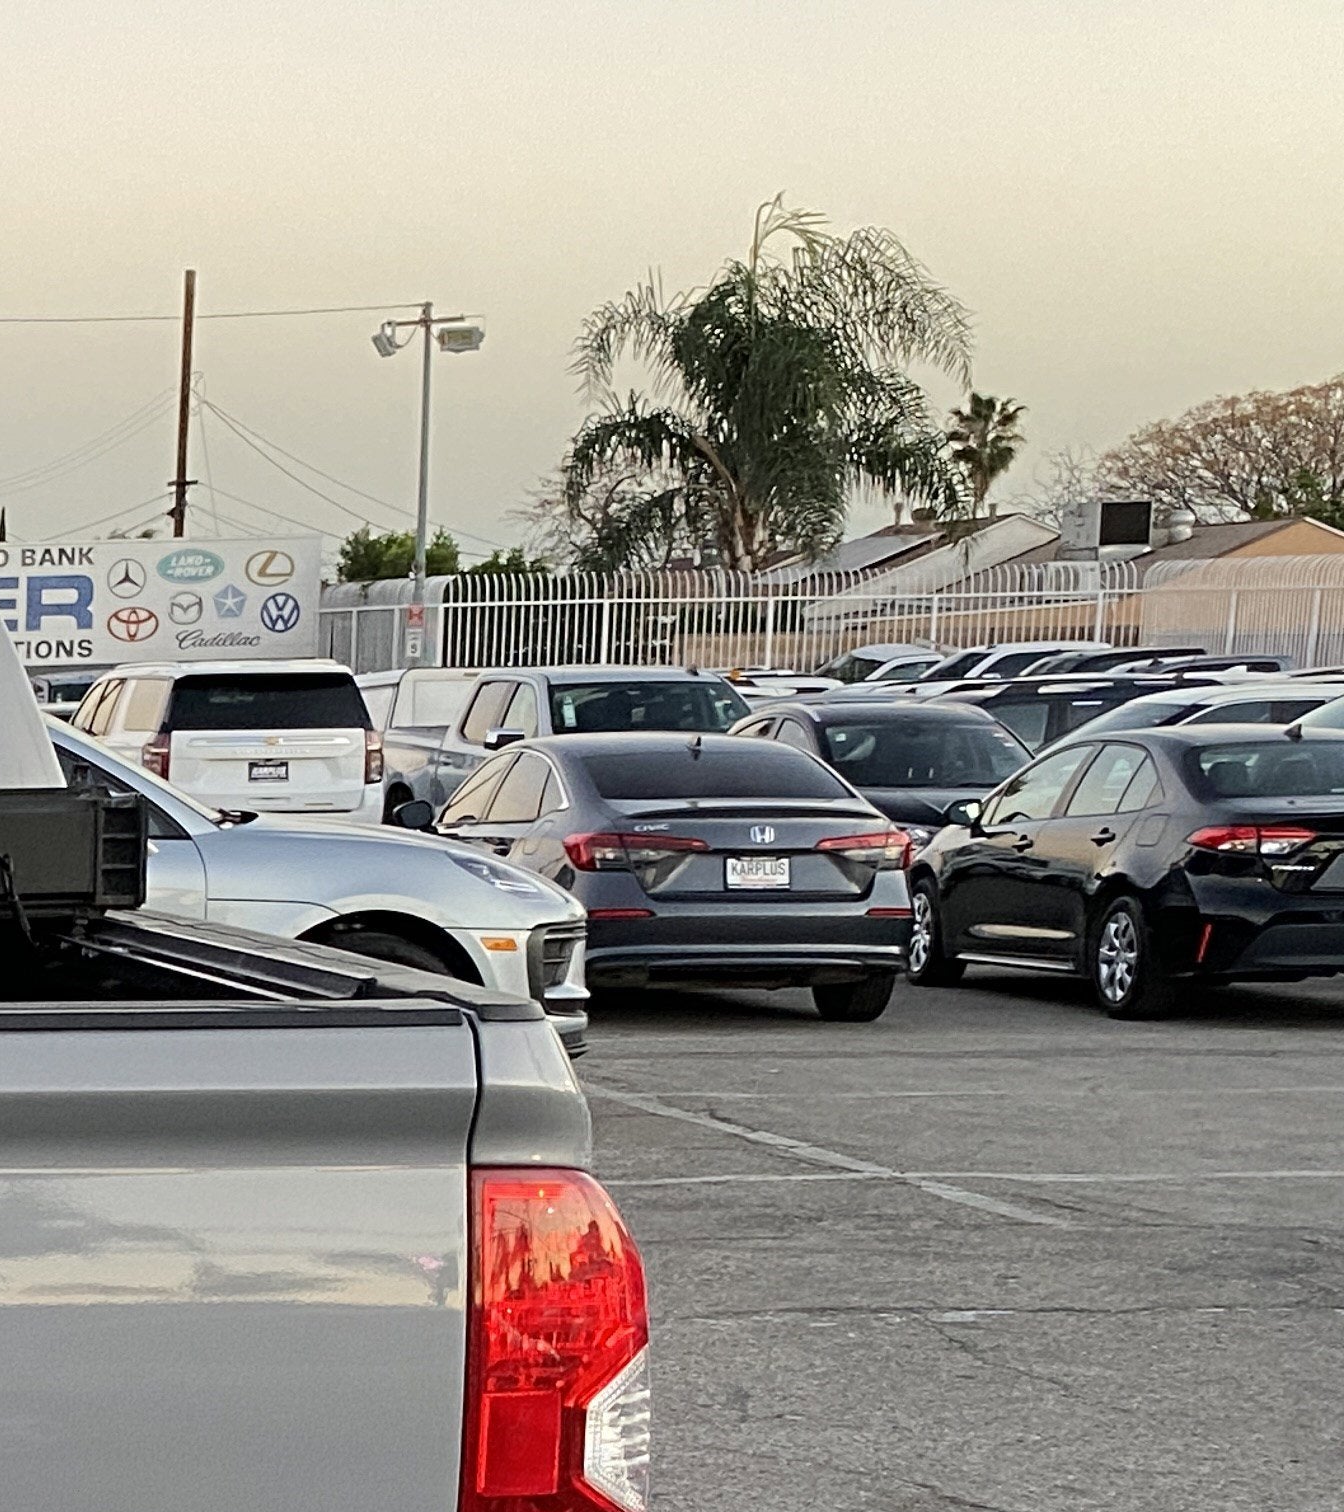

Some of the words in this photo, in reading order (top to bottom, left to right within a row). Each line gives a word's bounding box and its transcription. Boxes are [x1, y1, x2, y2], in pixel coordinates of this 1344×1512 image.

[21, 547, 95, 566] BANK
[175, 629, 261, 650] Cadillac
[730, 862, 786, 876] KARPLUS
